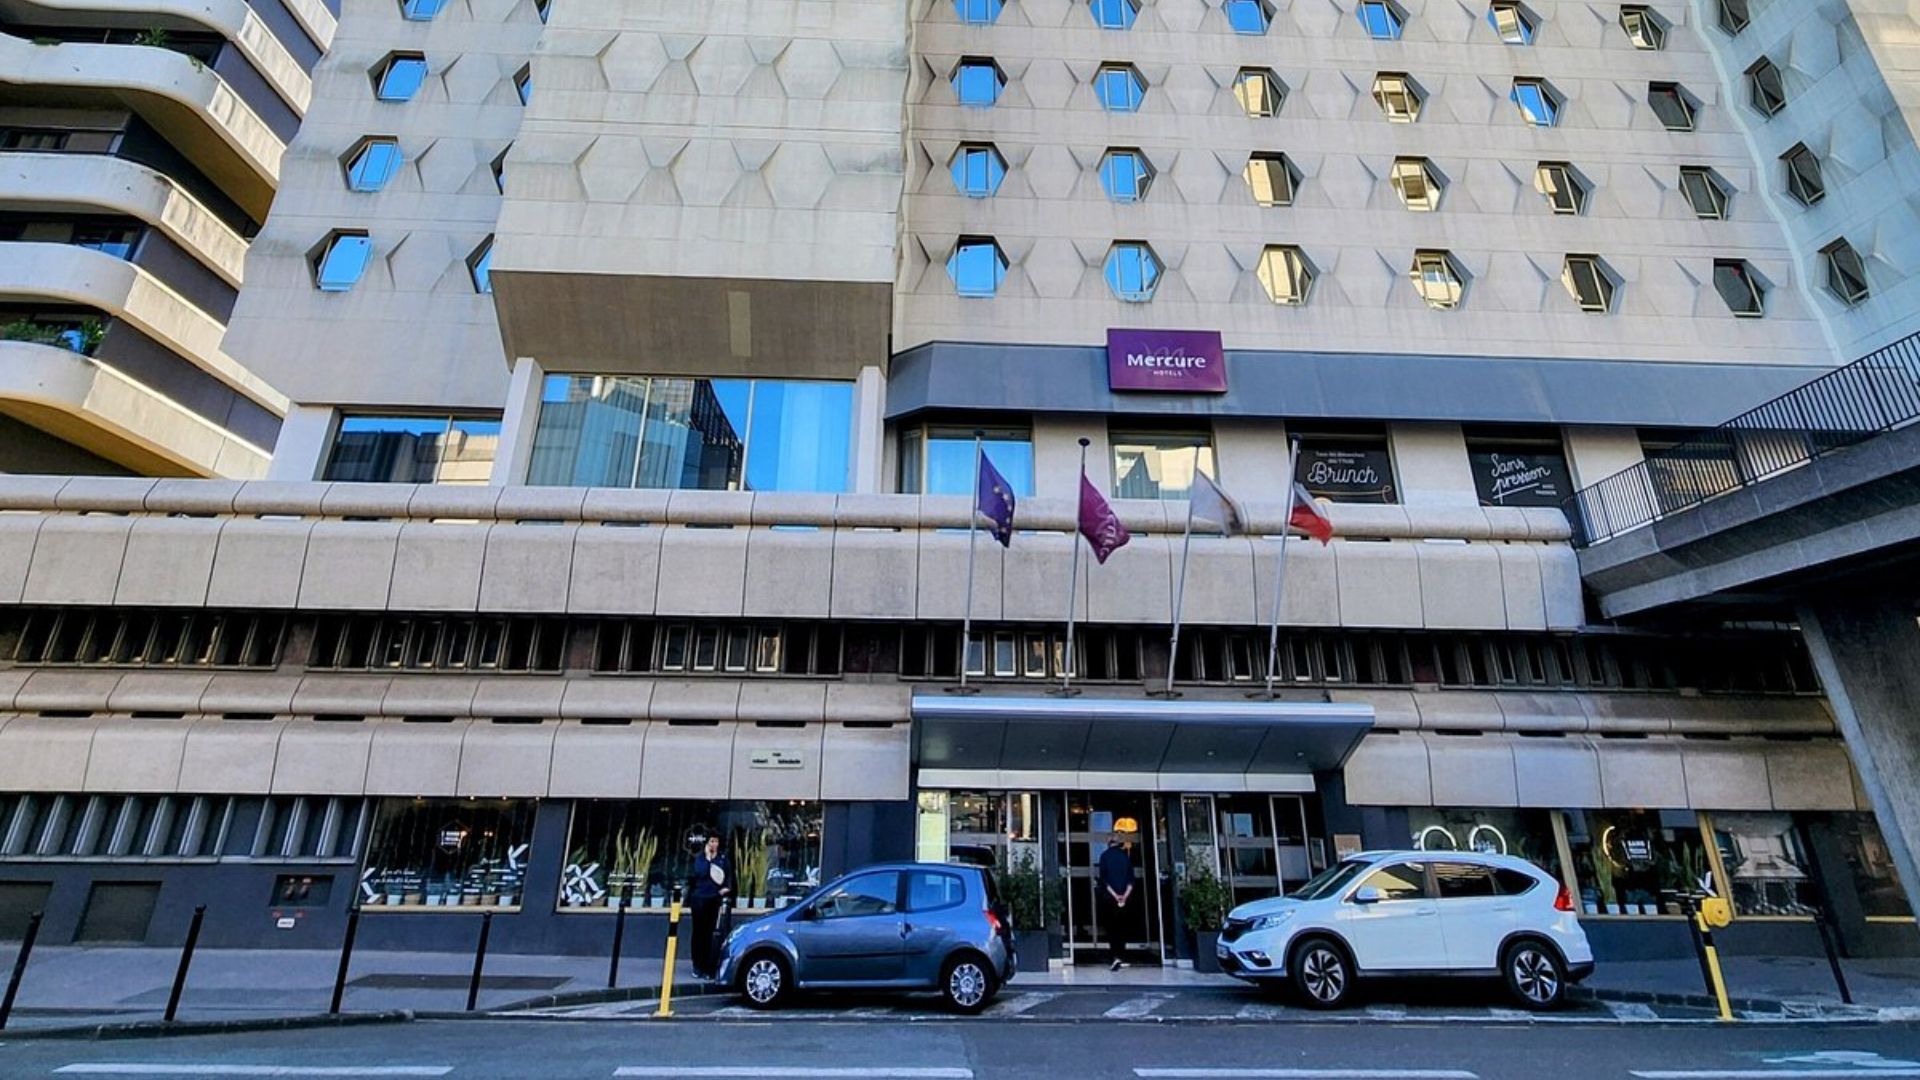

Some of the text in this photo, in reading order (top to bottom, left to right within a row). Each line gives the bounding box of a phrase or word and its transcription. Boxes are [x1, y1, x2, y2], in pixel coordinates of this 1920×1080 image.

[1127, 353, 1206, 368] Mercure
[1307, 461, 1378, 484] Brunch
[1491, 453, 1527, 477] Sans
